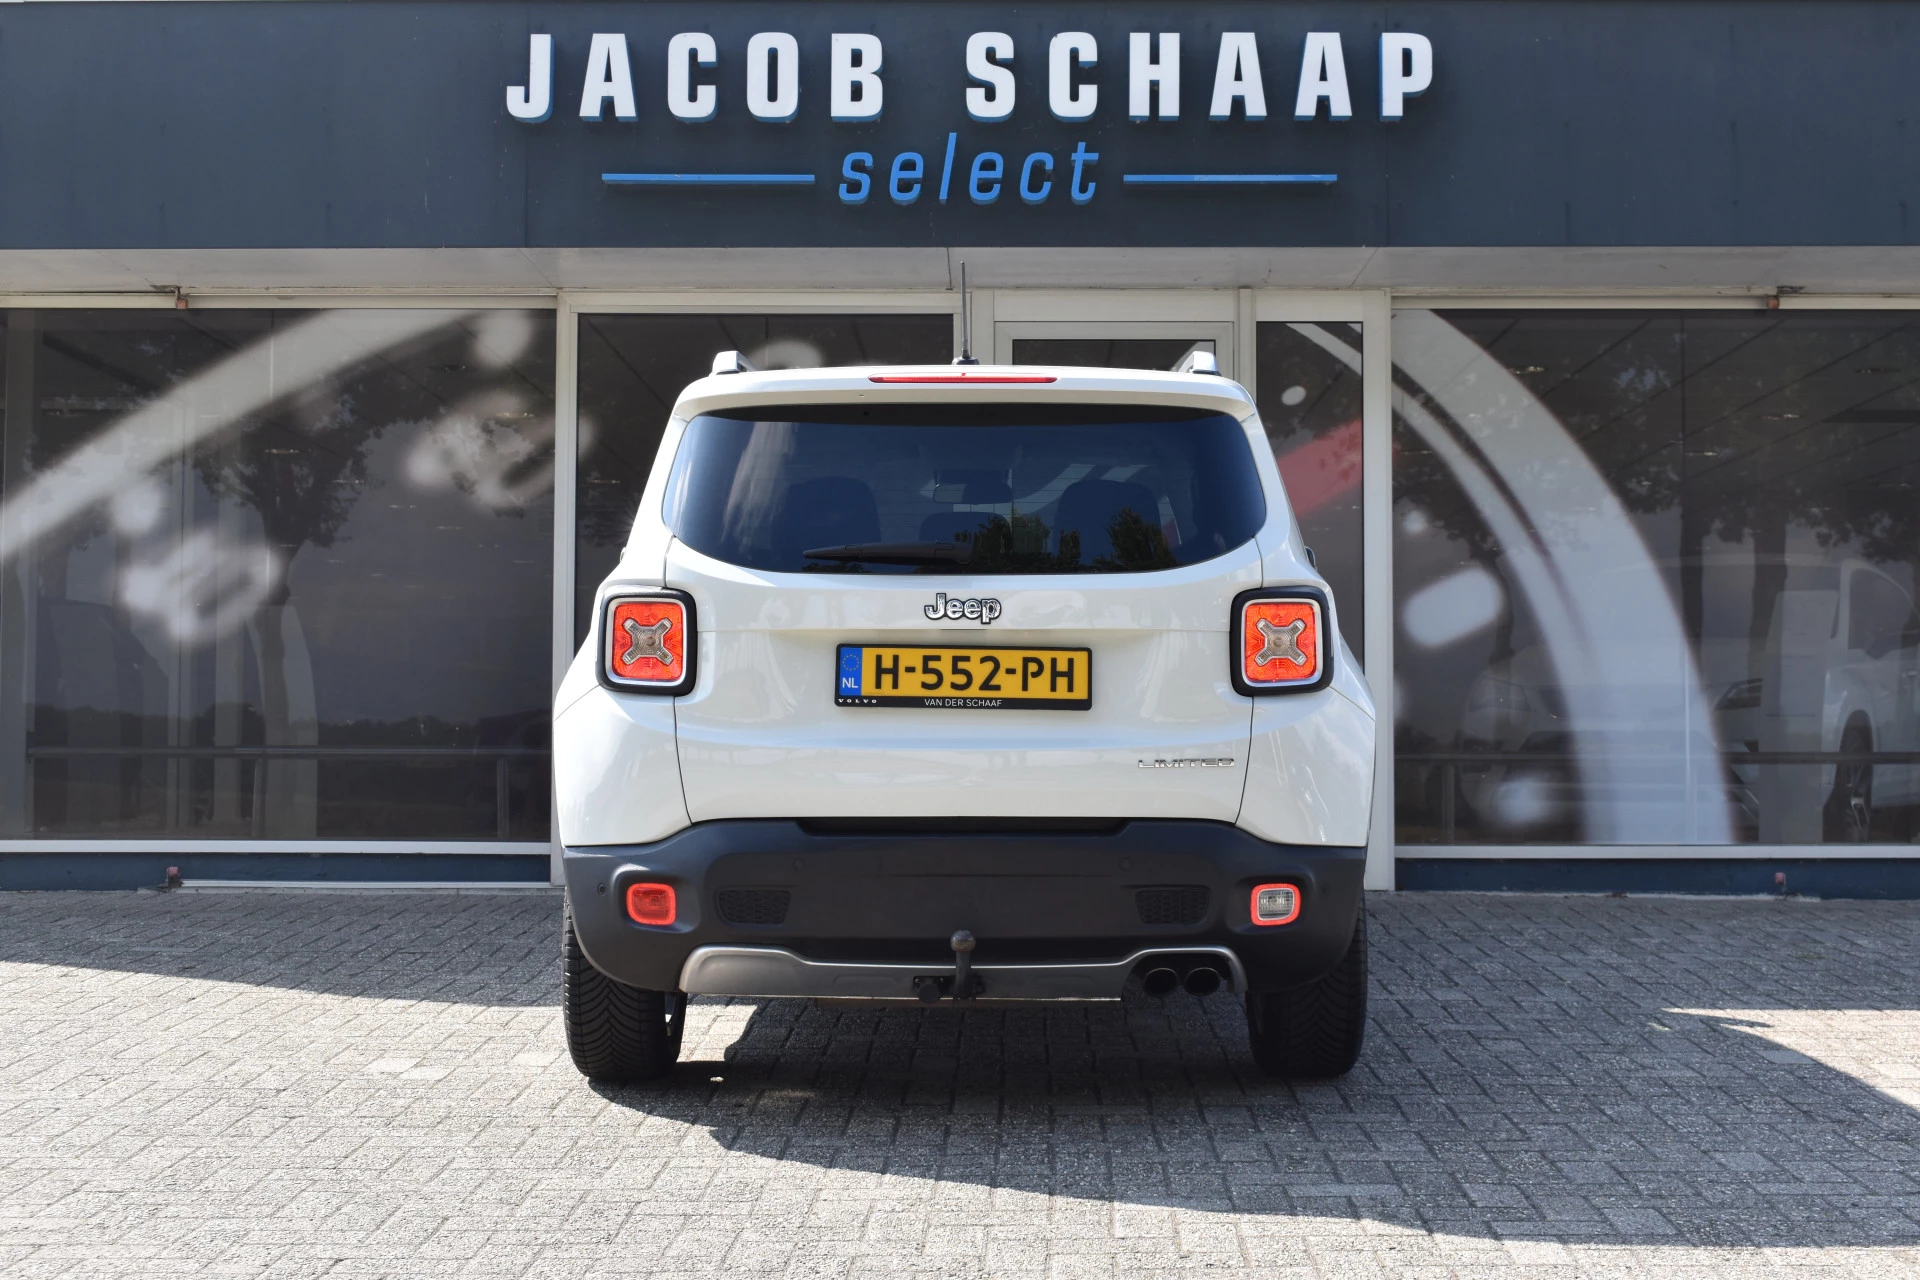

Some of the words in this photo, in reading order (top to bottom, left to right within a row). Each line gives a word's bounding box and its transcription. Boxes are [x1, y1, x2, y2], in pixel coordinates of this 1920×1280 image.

[506, 31, 884, 123] JACOB
[965, 31, 1434, 123] SCHAAP
[837, 132, 1100, 206] select
[924, 593, 1002, 624] Jeep
[842, 677, 859, 689] NL
[874, 653, 1075, 693] H-552-PH
[924, 698, 943, 707] VAN
[945, 698, 964, 707] DER
[965, 698, 1003, 708] SCHAAF
[1138, 758, 1235, 768] LIMITED
